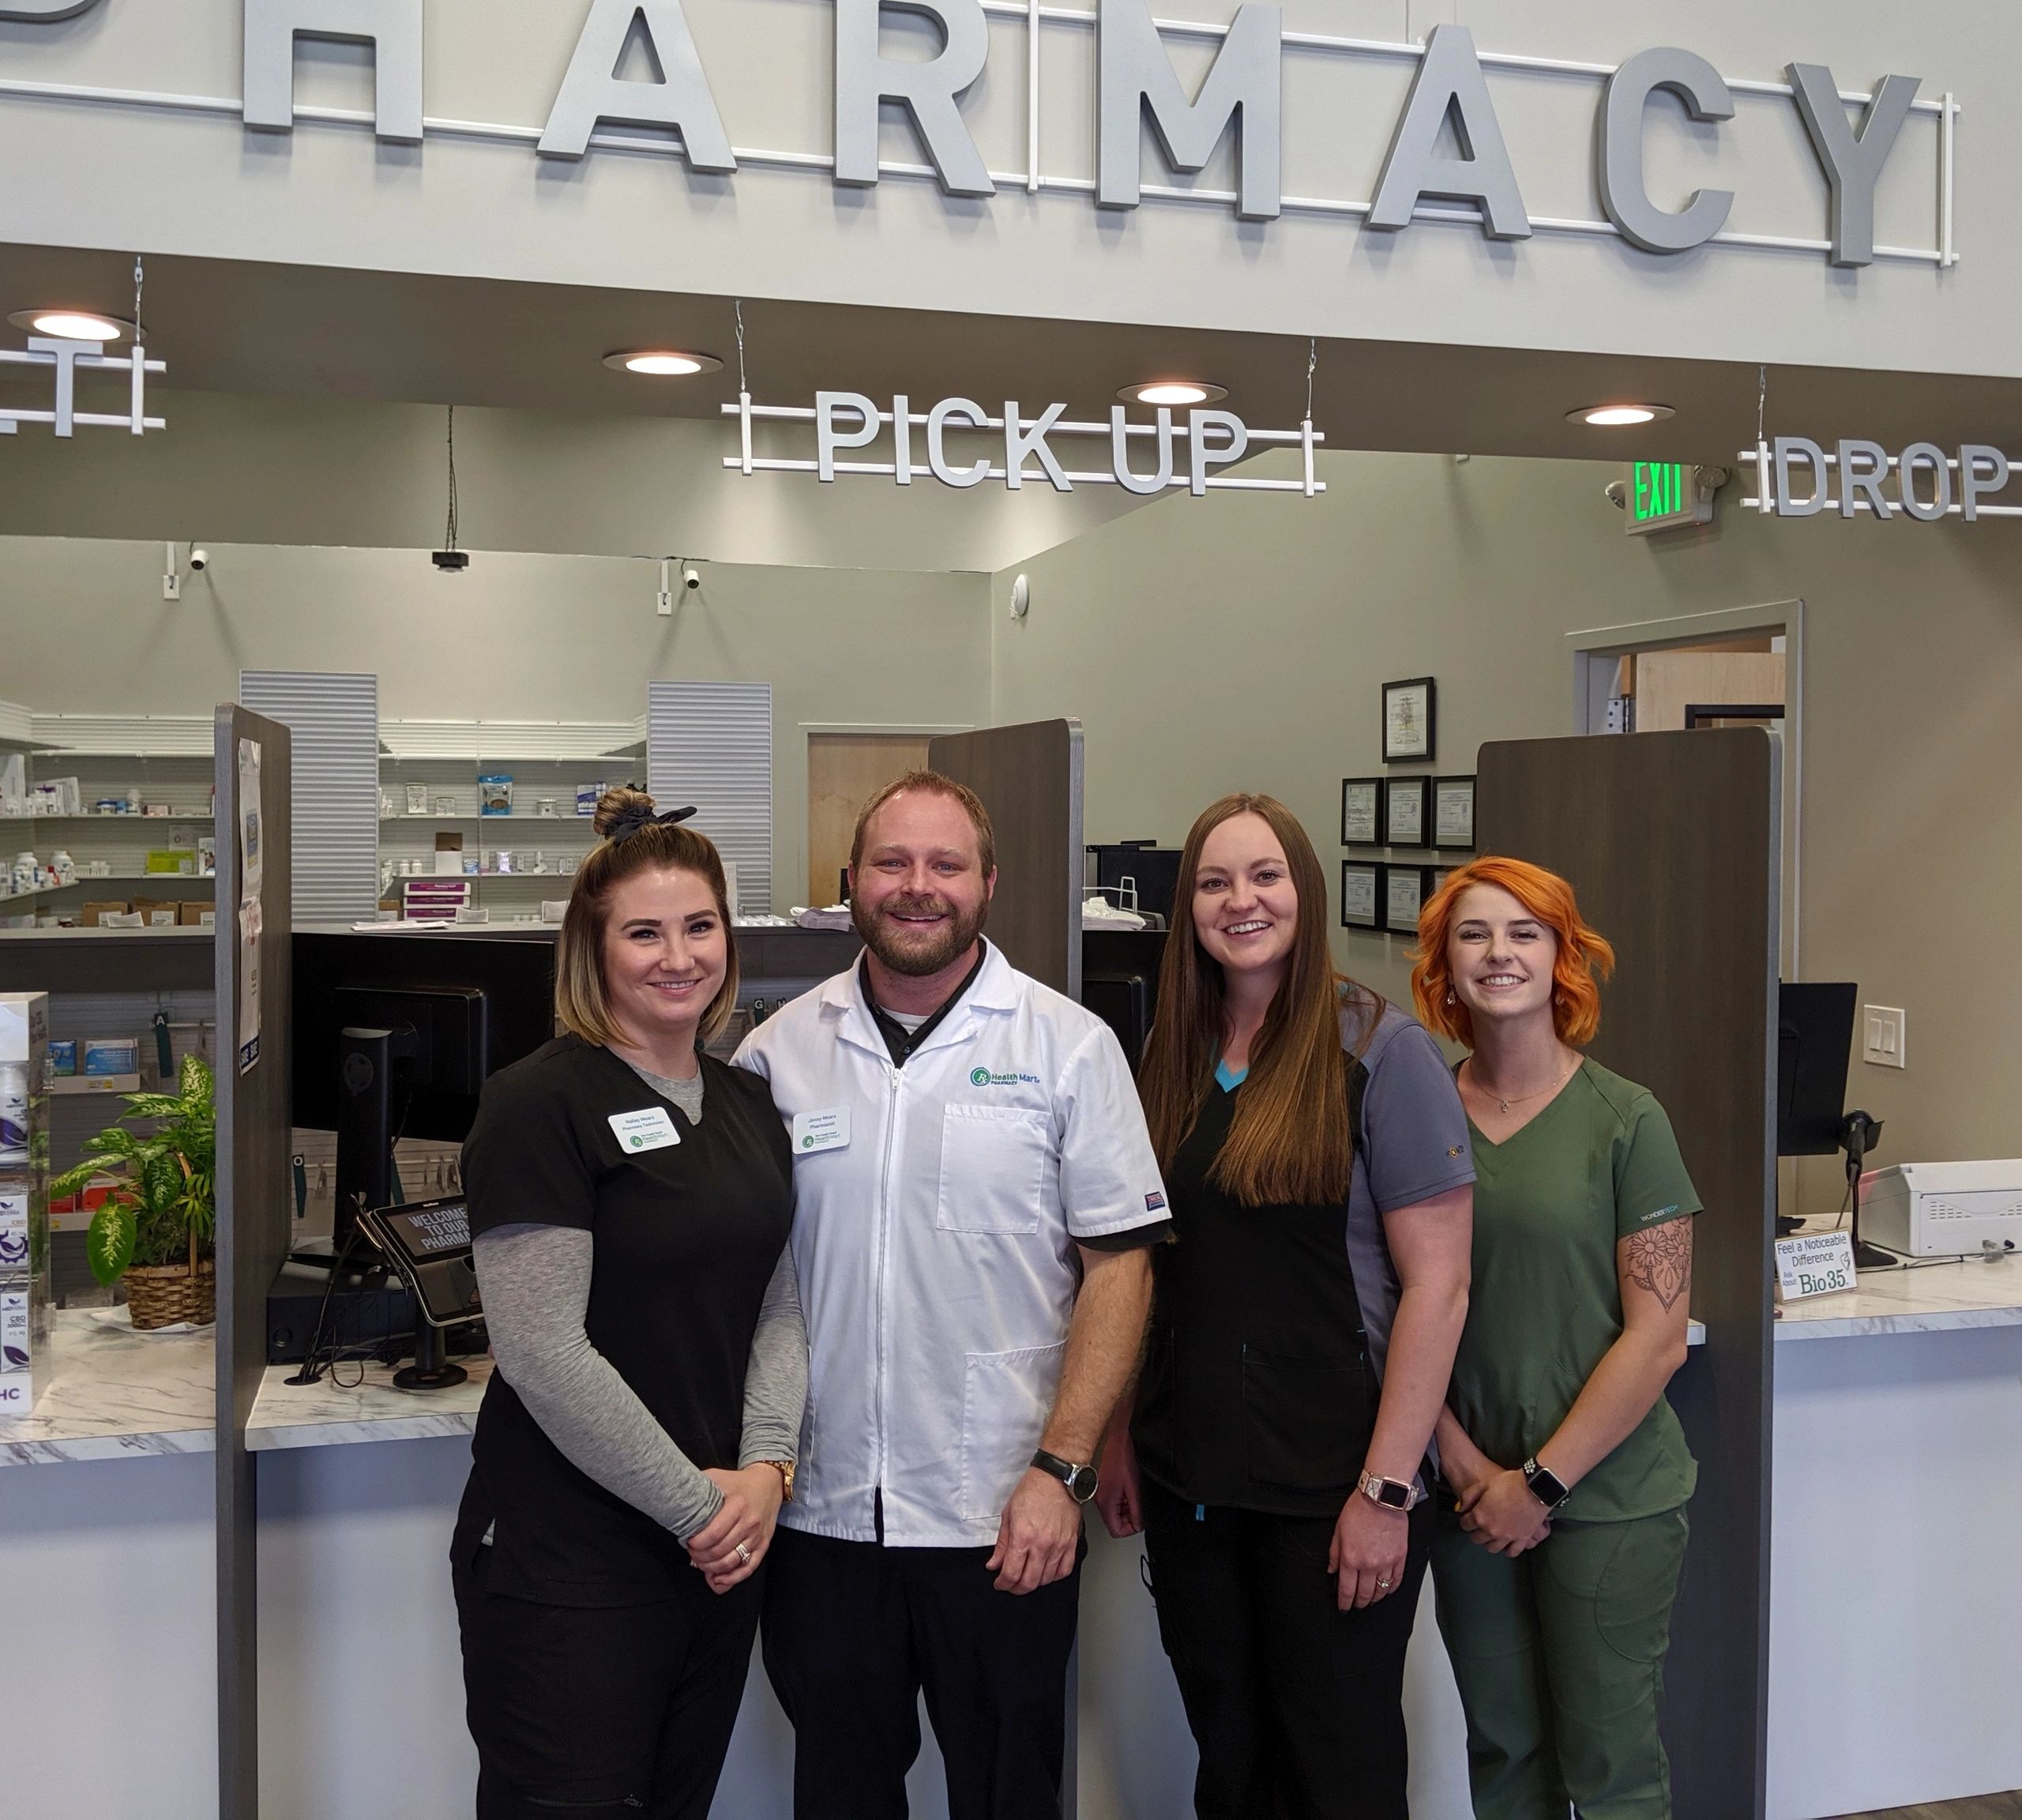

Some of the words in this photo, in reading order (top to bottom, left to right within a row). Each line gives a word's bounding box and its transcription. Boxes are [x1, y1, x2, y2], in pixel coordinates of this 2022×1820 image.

[0, 0, 1922, 268] HARMACY
[815, 390, 1074, 494] PICK
[1111, 405, 1249, 497] UP
[1773, 436, 2009, 523] DROP
[1634, 461, 1681, 521] EXIT
[754, 999, 763, 1010] G
[156, 1014, 165, 1025] A
[408, 1207, 468, 1228] WELCOME
[424, 1224, 444, 1237] TO
[442, 1220, 470, 1233] OUR
[1777, 1242, 1795, 1254] Feel
[1797, 1243, 1802, 1252] a
[1804, 1234, 1847, 1250] Noticeable
[1791, 1252, 1834, 1267] Difference
